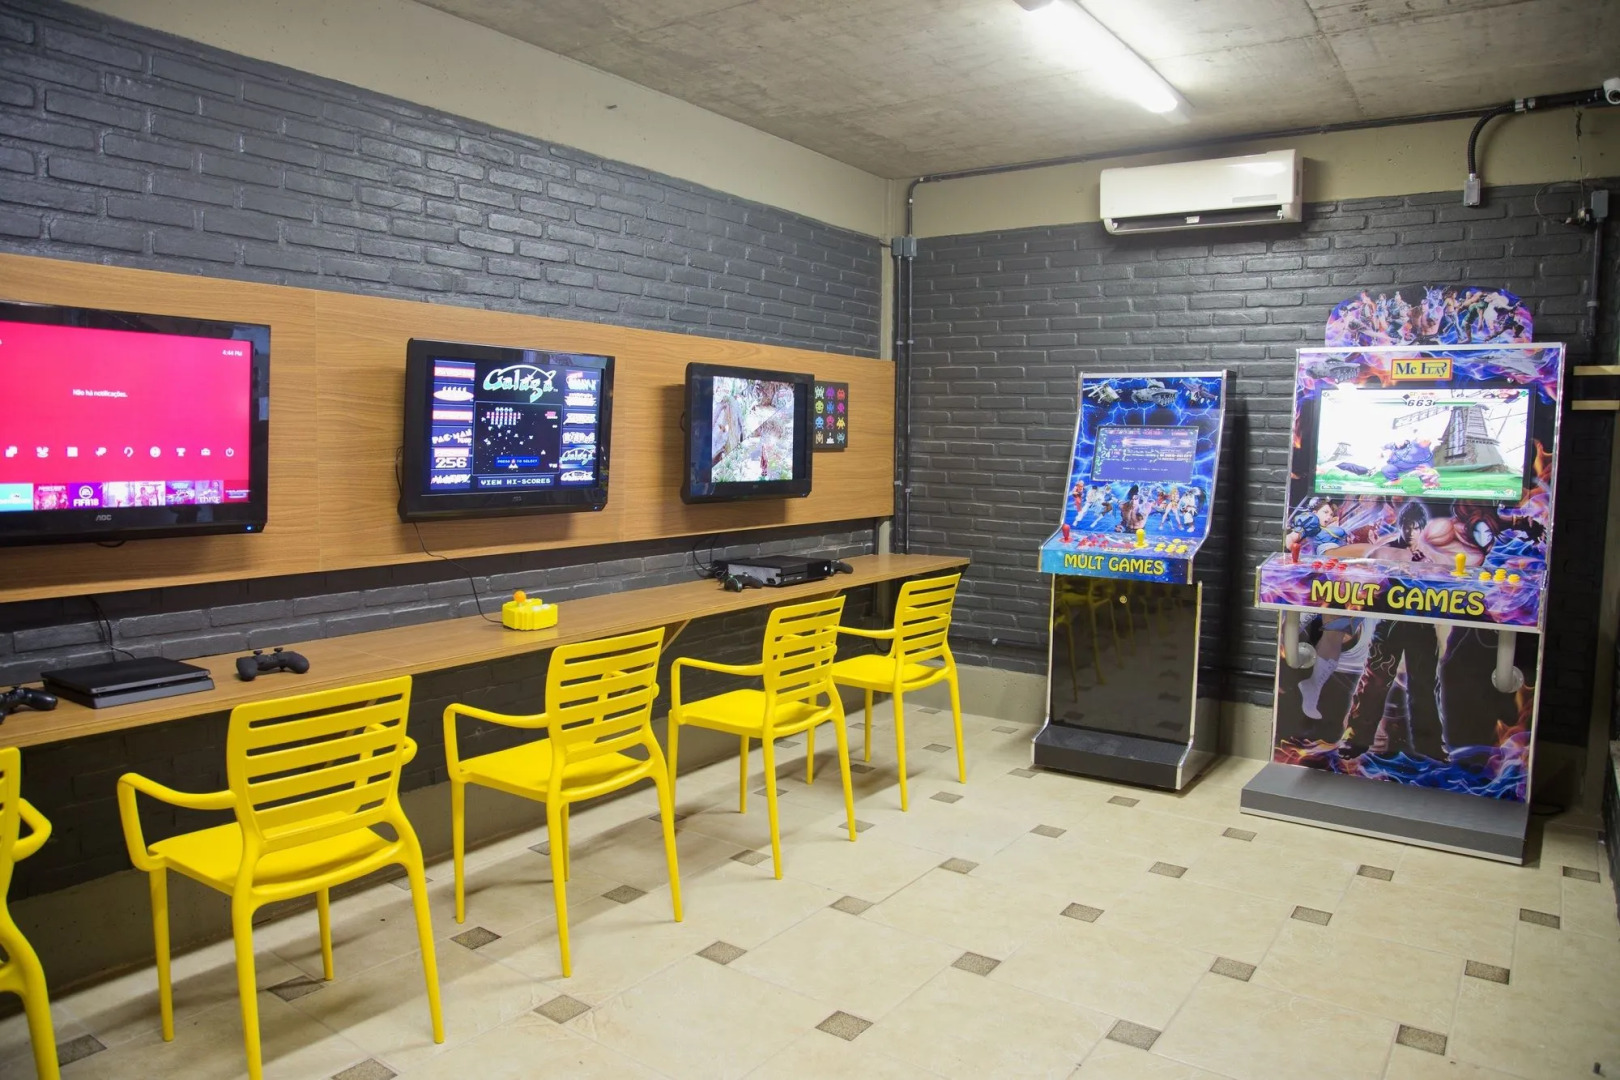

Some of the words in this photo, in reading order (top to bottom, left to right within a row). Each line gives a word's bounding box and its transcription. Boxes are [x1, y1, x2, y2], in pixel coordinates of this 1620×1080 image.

[1395, 362, 1417, 375] Mc
[483, 364, 557, 403] Galaga
[1407, 399, 1433, 407] 663
[431, 428, 473, 445] PAC-MAN
[435, 457, 468, 469] 256
[506, 477, 552, 485] HI-SCORES
[1064, 553, 1104, 570] MULT
[1108, 557, 1165, 575] GAMES
[1311, 579, 1381, 606] MULT
[1386, 585, 1487, 616] GAMES
